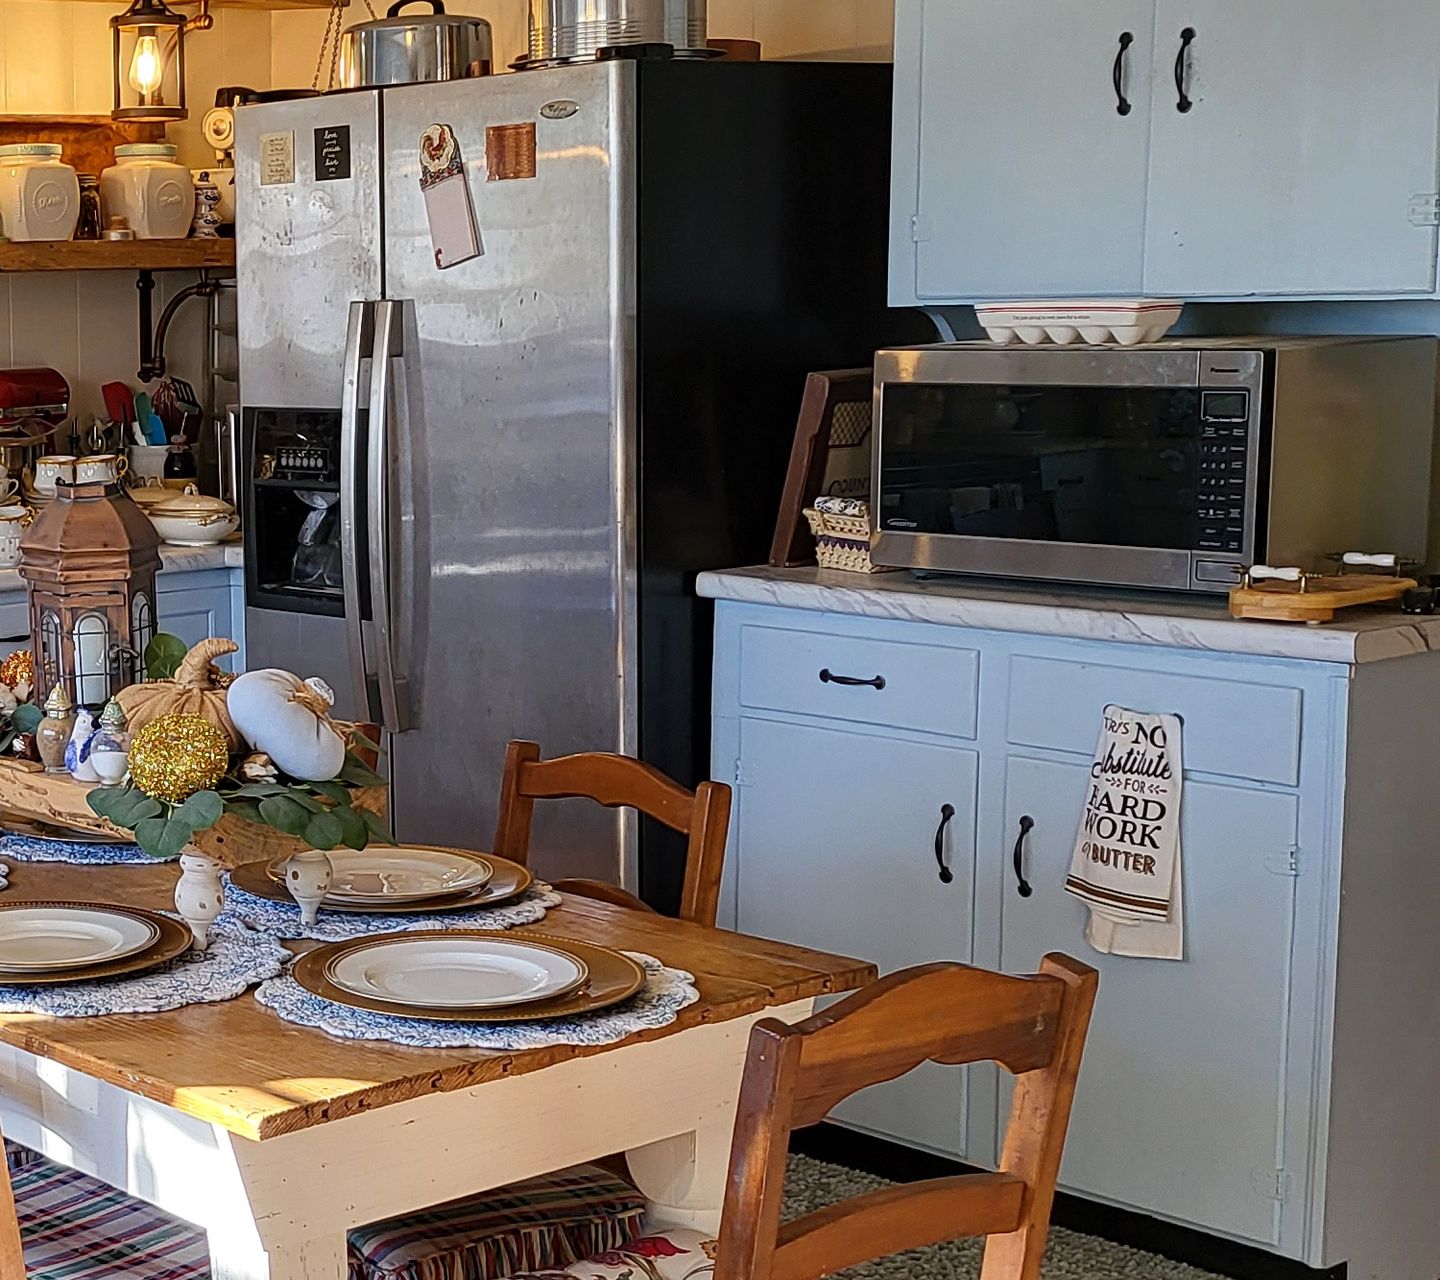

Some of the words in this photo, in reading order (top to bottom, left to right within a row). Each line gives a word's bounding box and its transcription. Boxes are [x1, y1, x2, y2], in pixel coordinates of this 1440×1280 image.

[1131, 722, 1167, 749] NO
[1088, 784, 1166, 822] HARD
[1123, 778, 1146, 794] FOR
[1085, 807, 1162, 849] WORK
[1091, 842, 1156, 876] BUTTER
